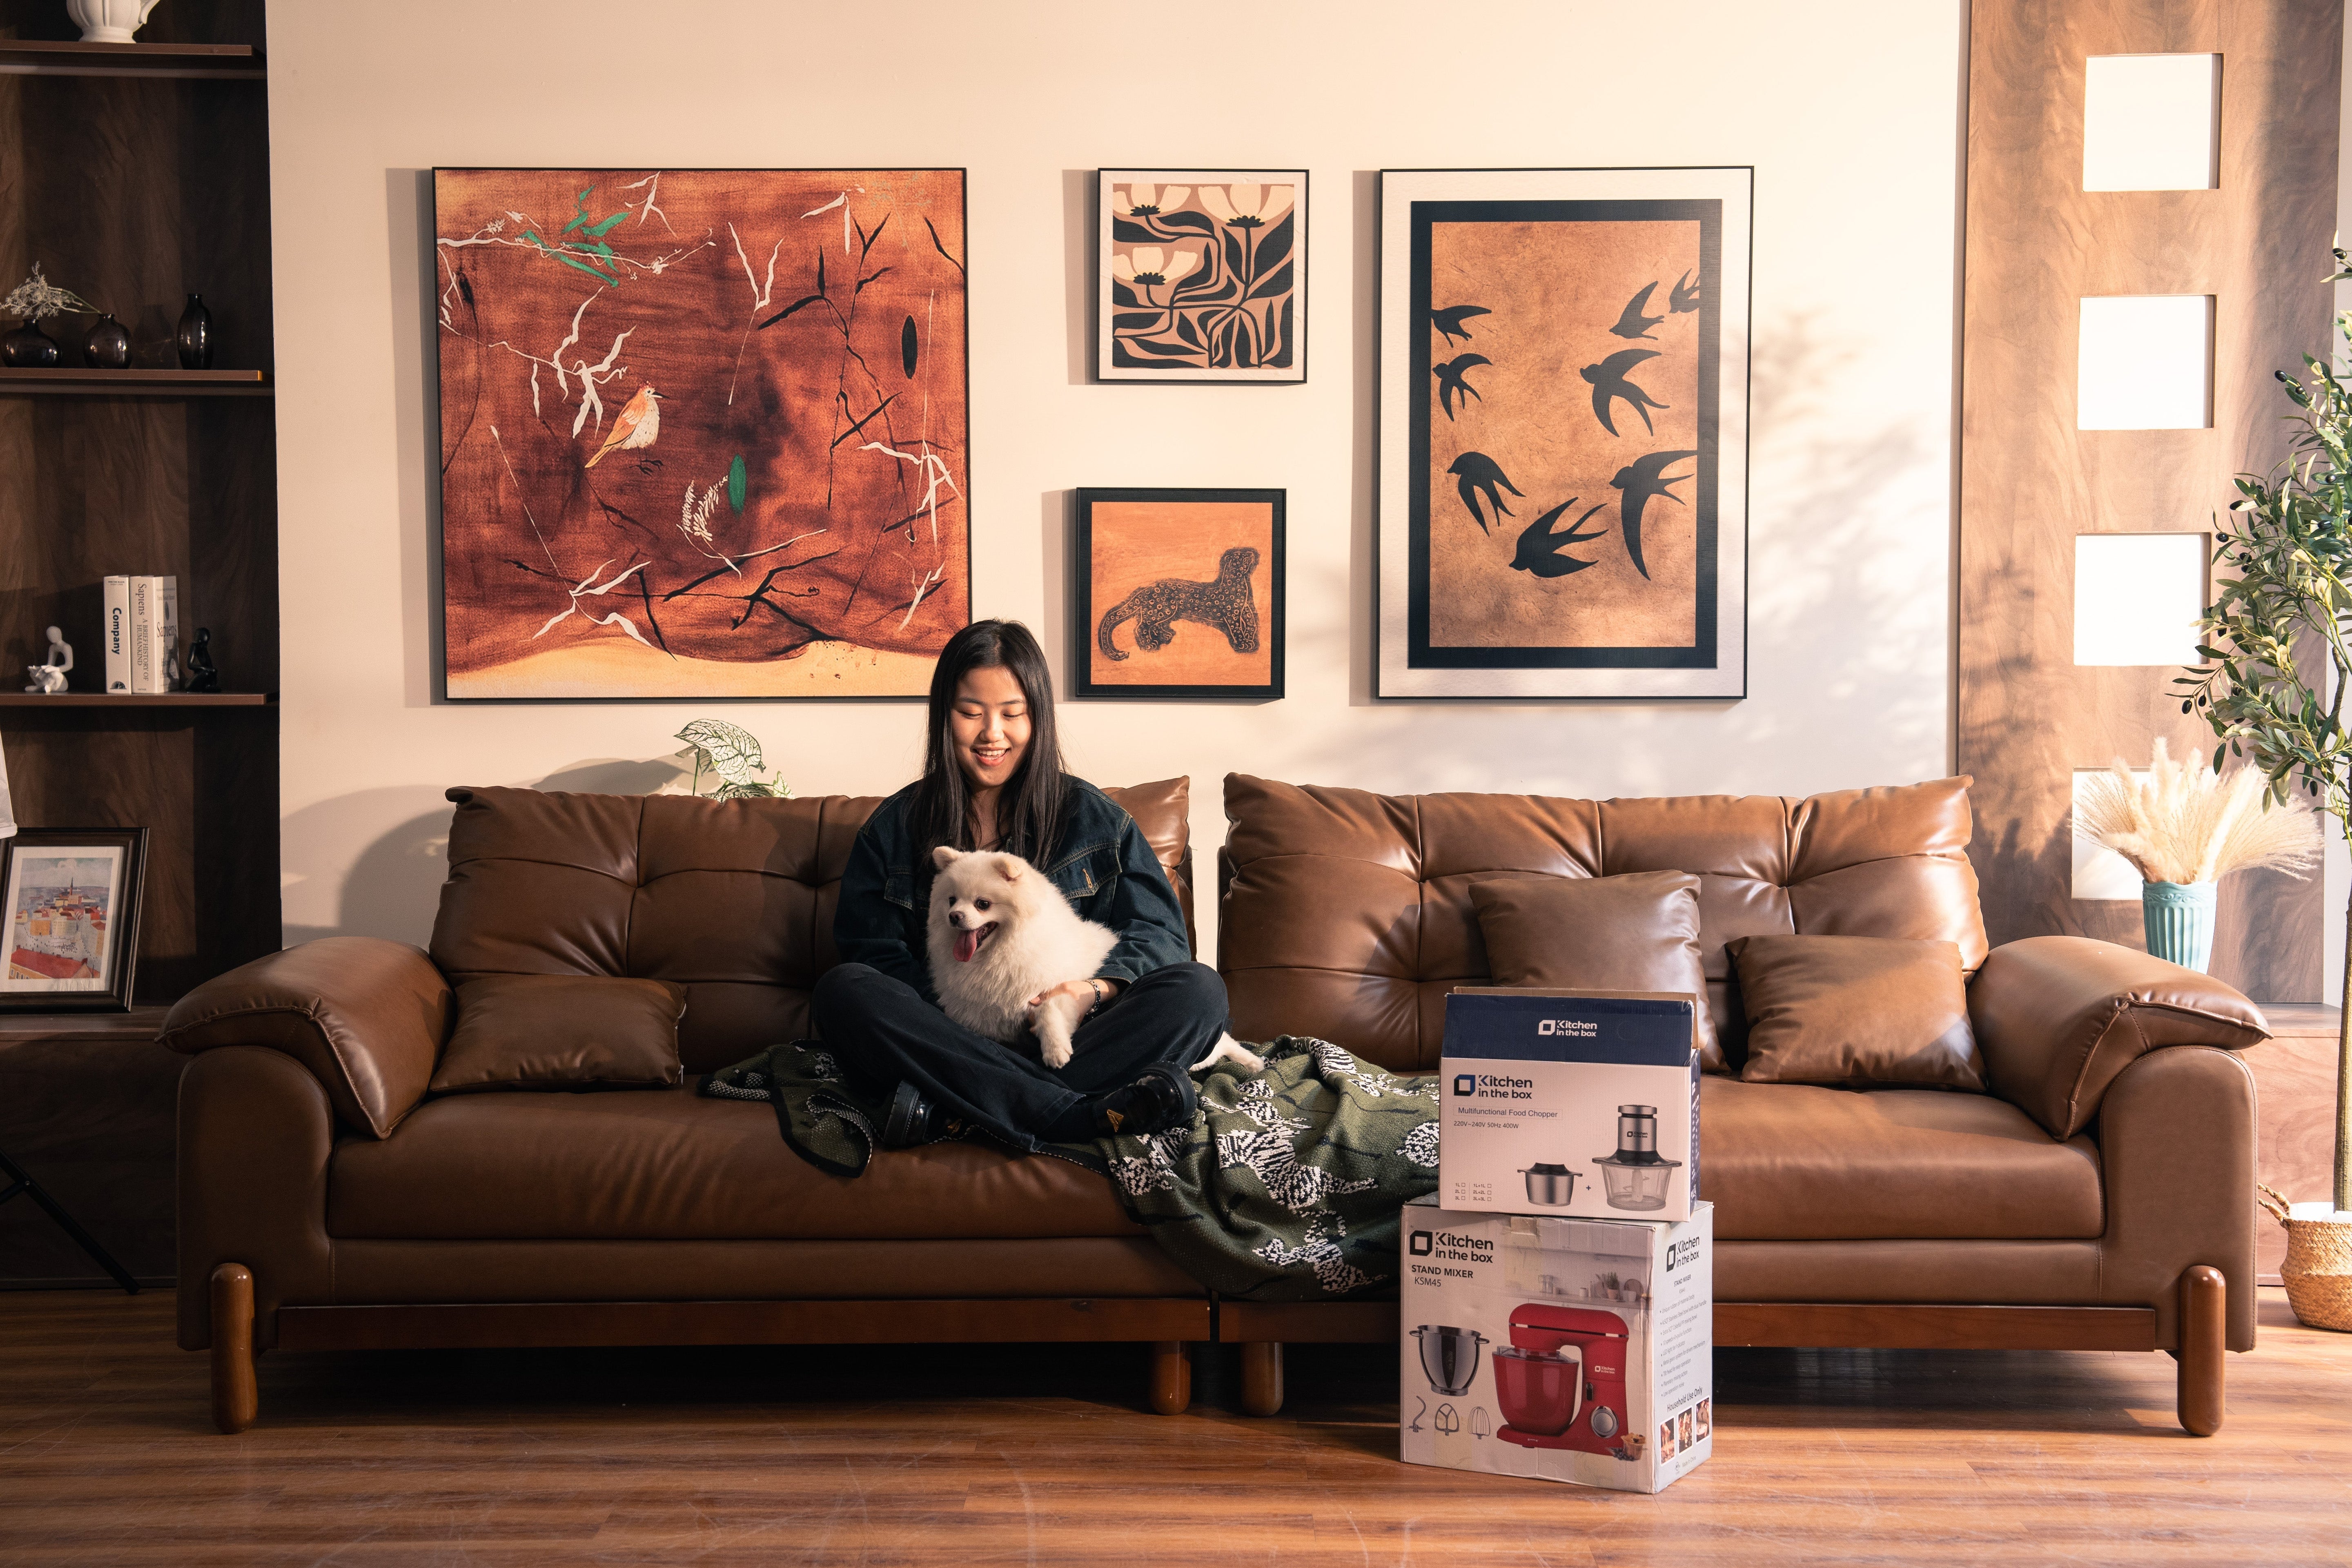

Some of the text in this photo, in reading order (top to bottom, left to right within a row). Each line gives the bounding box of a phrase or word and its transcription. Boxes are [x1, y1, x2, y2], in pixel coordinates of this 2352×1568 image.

[136, 584, 147, 615] Sapiens
[111, 607, 122, 655] Company
[157, 622, 177, 638] Sapiens
[143, 672, 148, 681] OF
[1557, 1020, 1597, 1029] Kitchen
[1479, 1075, 1532, 1088] Kitchen
[1478, 1088, 1532, 1099] in the box
[1458, 1107, 1507, 1116] Multifunctional
[1528, 1110, 1558, 1118] Chopper
[1436, 1232, 1493, 1250] Kitchen
[1677, 1236, 1699, 1255] Kitchen
[1436, 1247, 1493, 1263] in the box
[1676, 1258, 1681, 1267] in
[1690, 1251, 1699, 1261] box
[1412, 1265, 1473, 1278] STAND MIXER
[1415, 1276, 1441, 1287] KSM45
[1674, 1278, 1683, 1287] STAND
[1667, 1395, 1686, 1412] Household
[1695, 1386, 1703, 1396] Only
